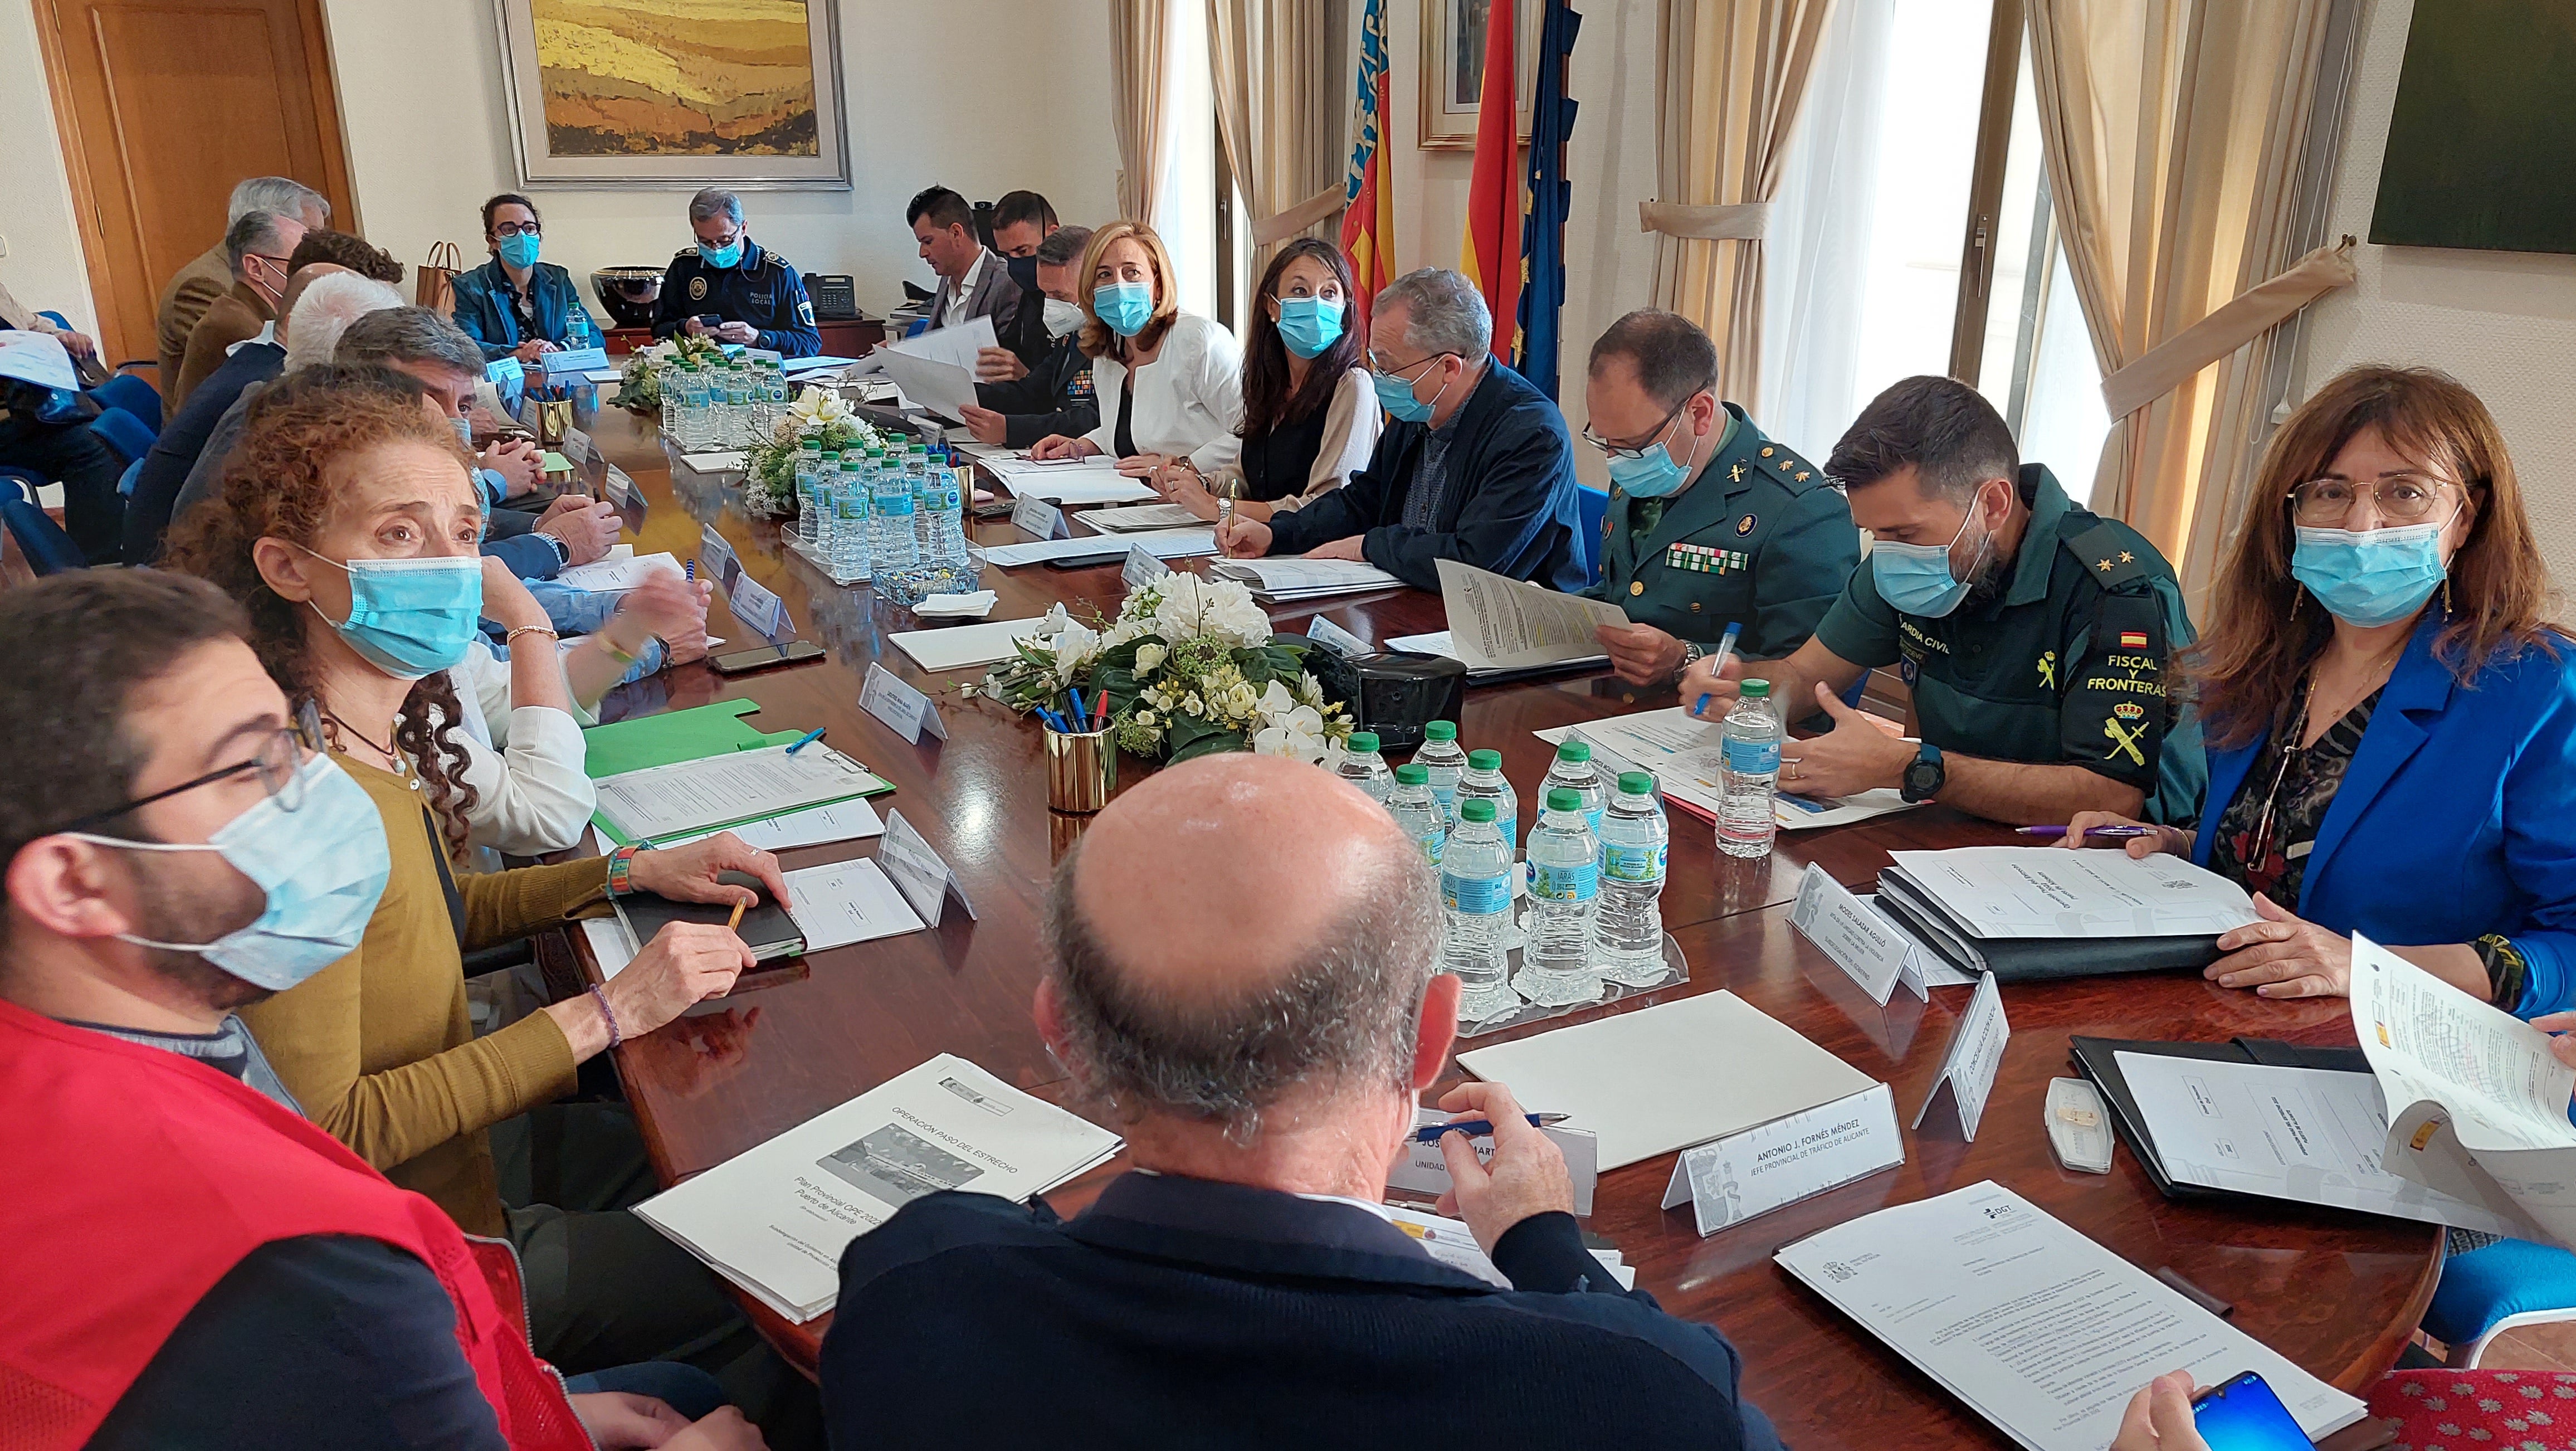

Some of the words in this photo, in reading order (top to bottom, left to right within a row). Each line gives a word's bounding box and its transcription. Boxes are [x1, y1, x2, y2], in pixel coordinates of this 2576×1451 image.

[2107, 654, 2158, 671] FISCAL
[2128, 669, 2139, 680] Y
[2087, 678, 2167, 698] FRONTERAS
[892, 1107, 938, 1134] OPERACIÓN
[935, 1131, 959, 1145] PASO
[957, 1141, 974, 1153] DEL
[973, 1150, 1018, 1174] ESTRECHO
[1422, 1140, 1440, 1148] JOS
[1474, 1146, 1495, 1157] ART
[1757, 1142, 1792, 1162] ANTONIO
[1794, 1139, 1801, 1150] J.
[1801, 1128, 1829, 1147] FORNÉS
[1831, 1118, 1860, 1139] MÉNDEZ
[1751, 1166, 1764, 1177] JEFE
[1764, 1153, 1800, 1173] PROVINCIAL
[1801, 1149, 1809, 1158] DE
[1809, 1140, 1833, 1156] TRÁFICO
[1834, 1137, 1842, 1147] DE
[1843, 1127, 1870, 1144] ALICANTE
[1415, 1160, 1445, 1171] UNIDAD
[794, 1176, 812, 1189] Plan
[810, 1185, 846, 1207] Provincial
[843, 1204, 863, 1217] OPE
[860, 1211, 883, 1225] 2022
[794, 1189, 819, 1205] Puerto
[827, 1208, 857, 1225] Alicante
[1995, 1205, 2012, 1215] DGT
